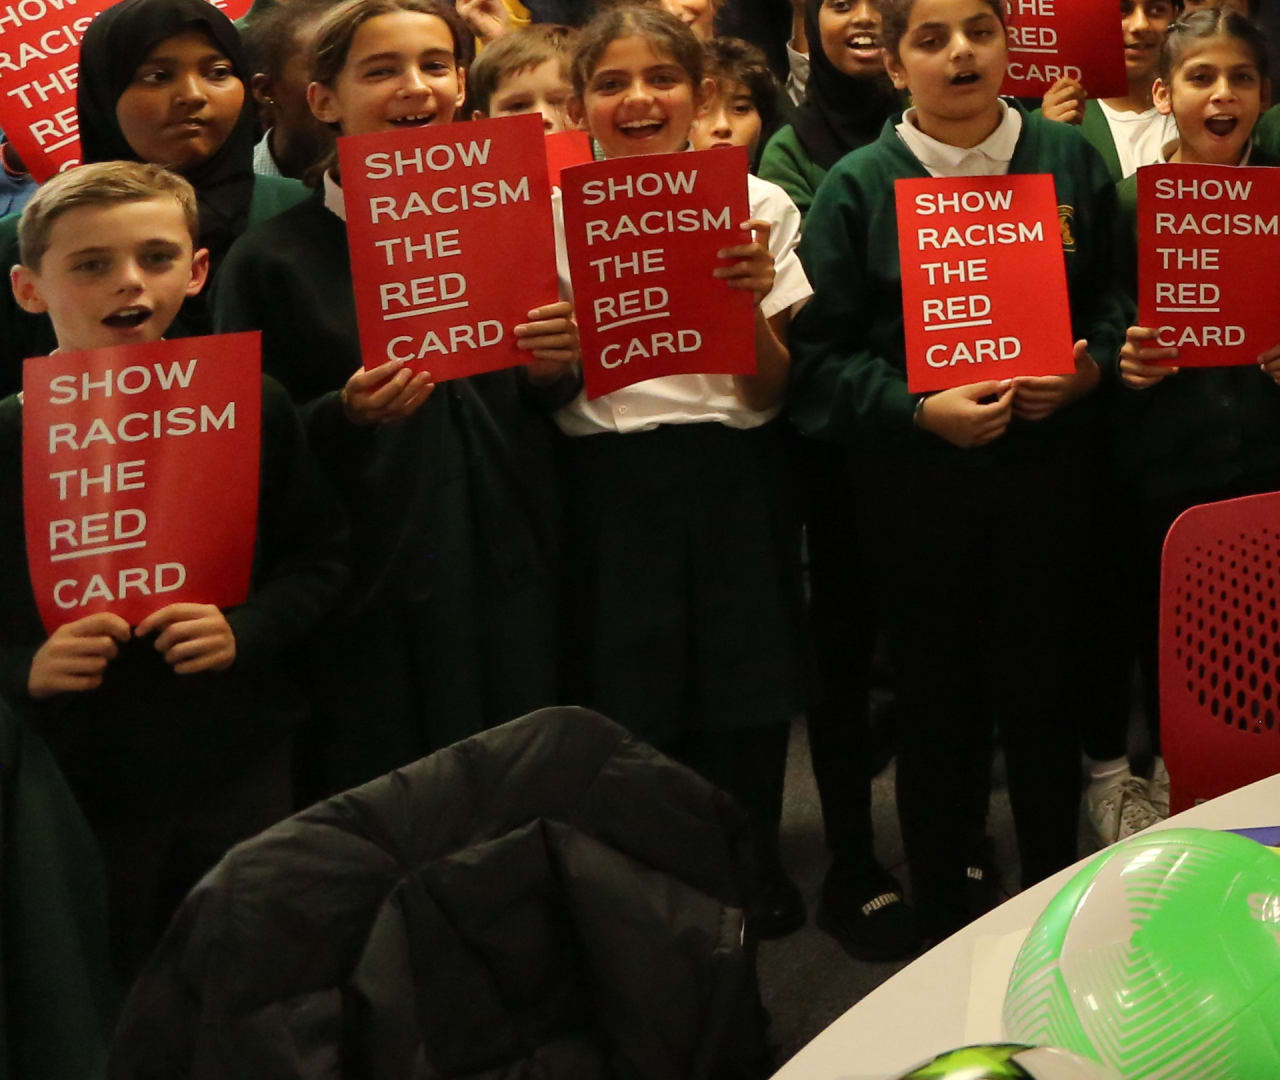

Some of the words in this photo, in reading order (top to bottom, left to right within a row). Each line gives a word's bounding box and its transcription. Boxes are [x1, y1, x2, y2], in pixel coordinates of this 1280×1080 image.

[365, 139, 491, 179] SHOW
[370, 177, 529, 223] RACISM
[583, 170, 697, 204] SHOW
[916, 190, 1012, 214] SHOW
[1156, 179, 1252, 200] SHOW
[586, 207, 730, 245] RACISM
[918, 222, 1043, 250] RACISM
[1156, 213, 1278, 235] RACISM
[375, 229, 461, 265] THE
[1156, 248, 1219, 269] THE
[590, 249, 665, 282] THE
[921, 259, 987, 285] THE
[380, 273, 466, 310] RED
[594, 287, 668, 323] RED
[923, 295, 990, 322] RED
[1156, 283, 1219, 304] RED
[386, 320, 503, 362] CARD
[601, 330, 701, 368] CARD
[926, 337, 1020, 367] CARD
[1158, 326, 1245, 346] CARD
[50, 360, 197, 404] SHOW
[50, 402, 235, 453] RACISM
[50, 460, 145, 500] THE
[50, 509, 146, 550] RED
[54, 563, 186, 608] CARD
